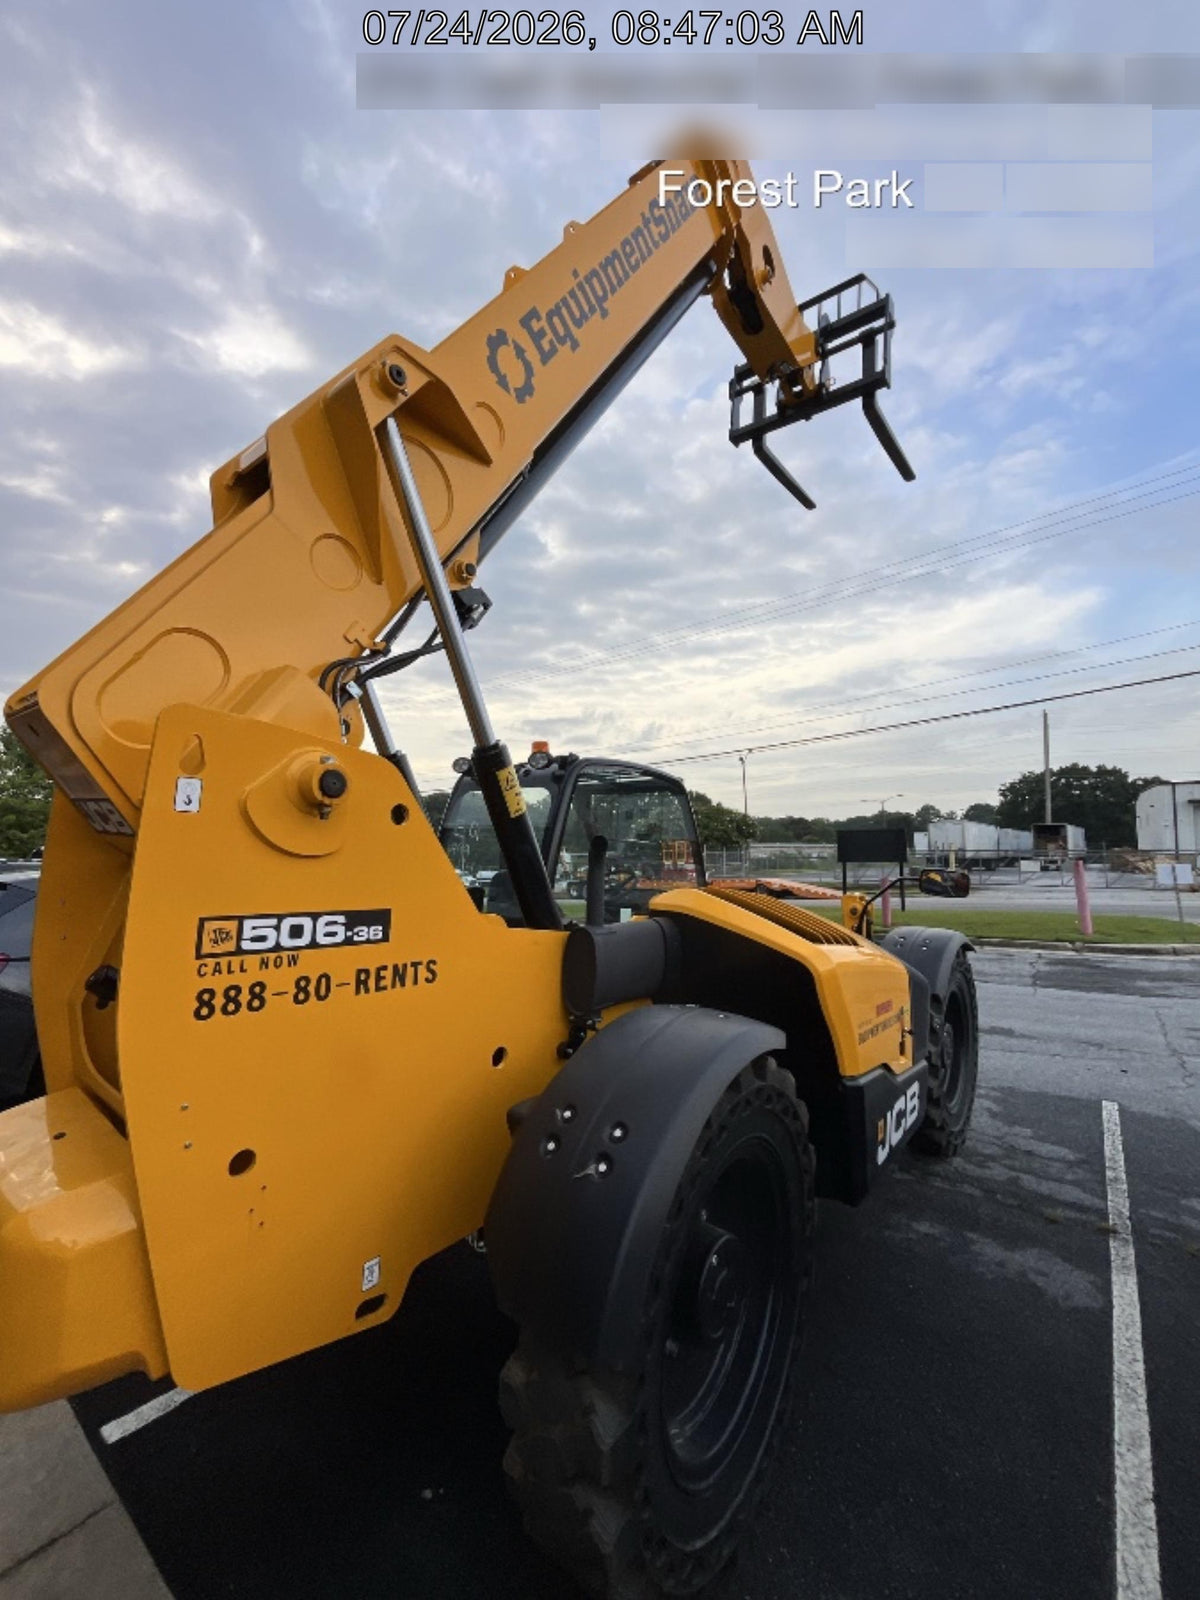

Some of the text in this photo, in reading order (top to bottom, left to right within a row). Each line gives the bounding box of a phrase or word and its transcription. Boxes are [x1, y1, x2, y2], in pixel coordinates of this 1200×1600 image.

[240, 914, 384, 951] 506-36
[193, 959, 438, 1021] 888-80-RENTS
[197, 953, 300, 978] CALL NOW
[876, 1080, 920, 1166] JCB
